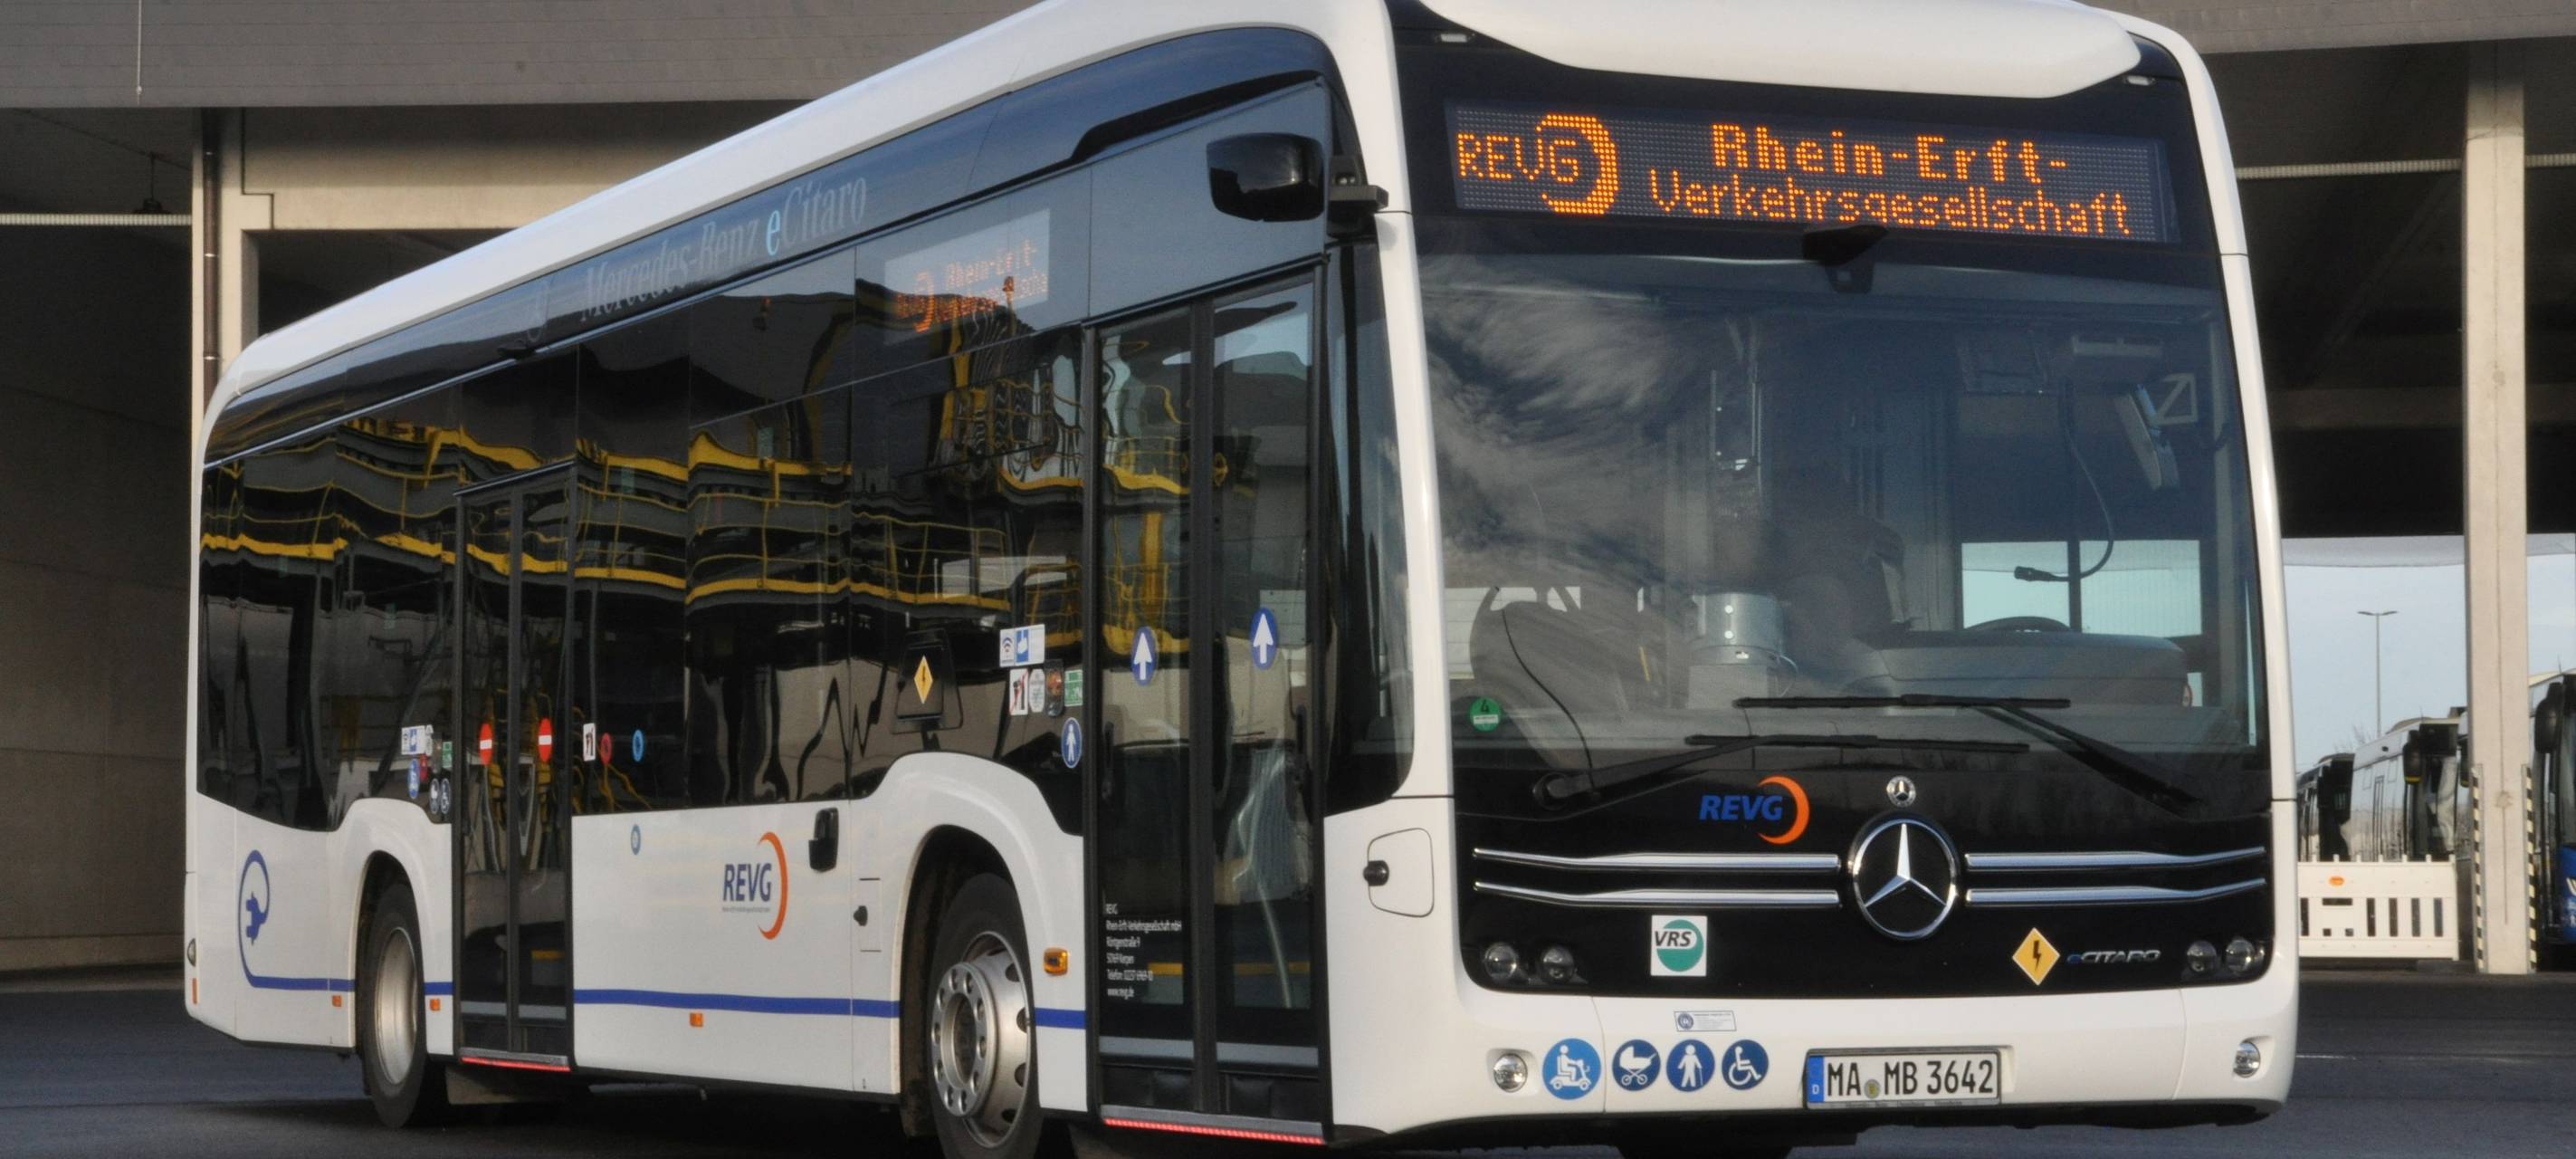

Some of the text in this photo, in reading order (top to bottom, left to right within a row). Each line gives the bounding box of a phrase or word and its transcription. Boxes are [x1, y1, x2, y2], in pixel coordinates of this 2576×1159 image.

[1458, 131, 1582, 184] REVG
[1711, 123, 2067, 185] Rhein-Erft-
[1649, 168, 2132, 235] Verkehrsgesellschaft
[580, 177, 867, 322] Mercedes-Benz eCitaro
[1481, 699, 1490, 714] 4
[1700, 795, 1783, 821] REVG
[723, 863, 772, 902] REVG
[1655, 931, 1692, 947] VRS
[1812, 1059, 1993, 1097] D MA MB 3642
